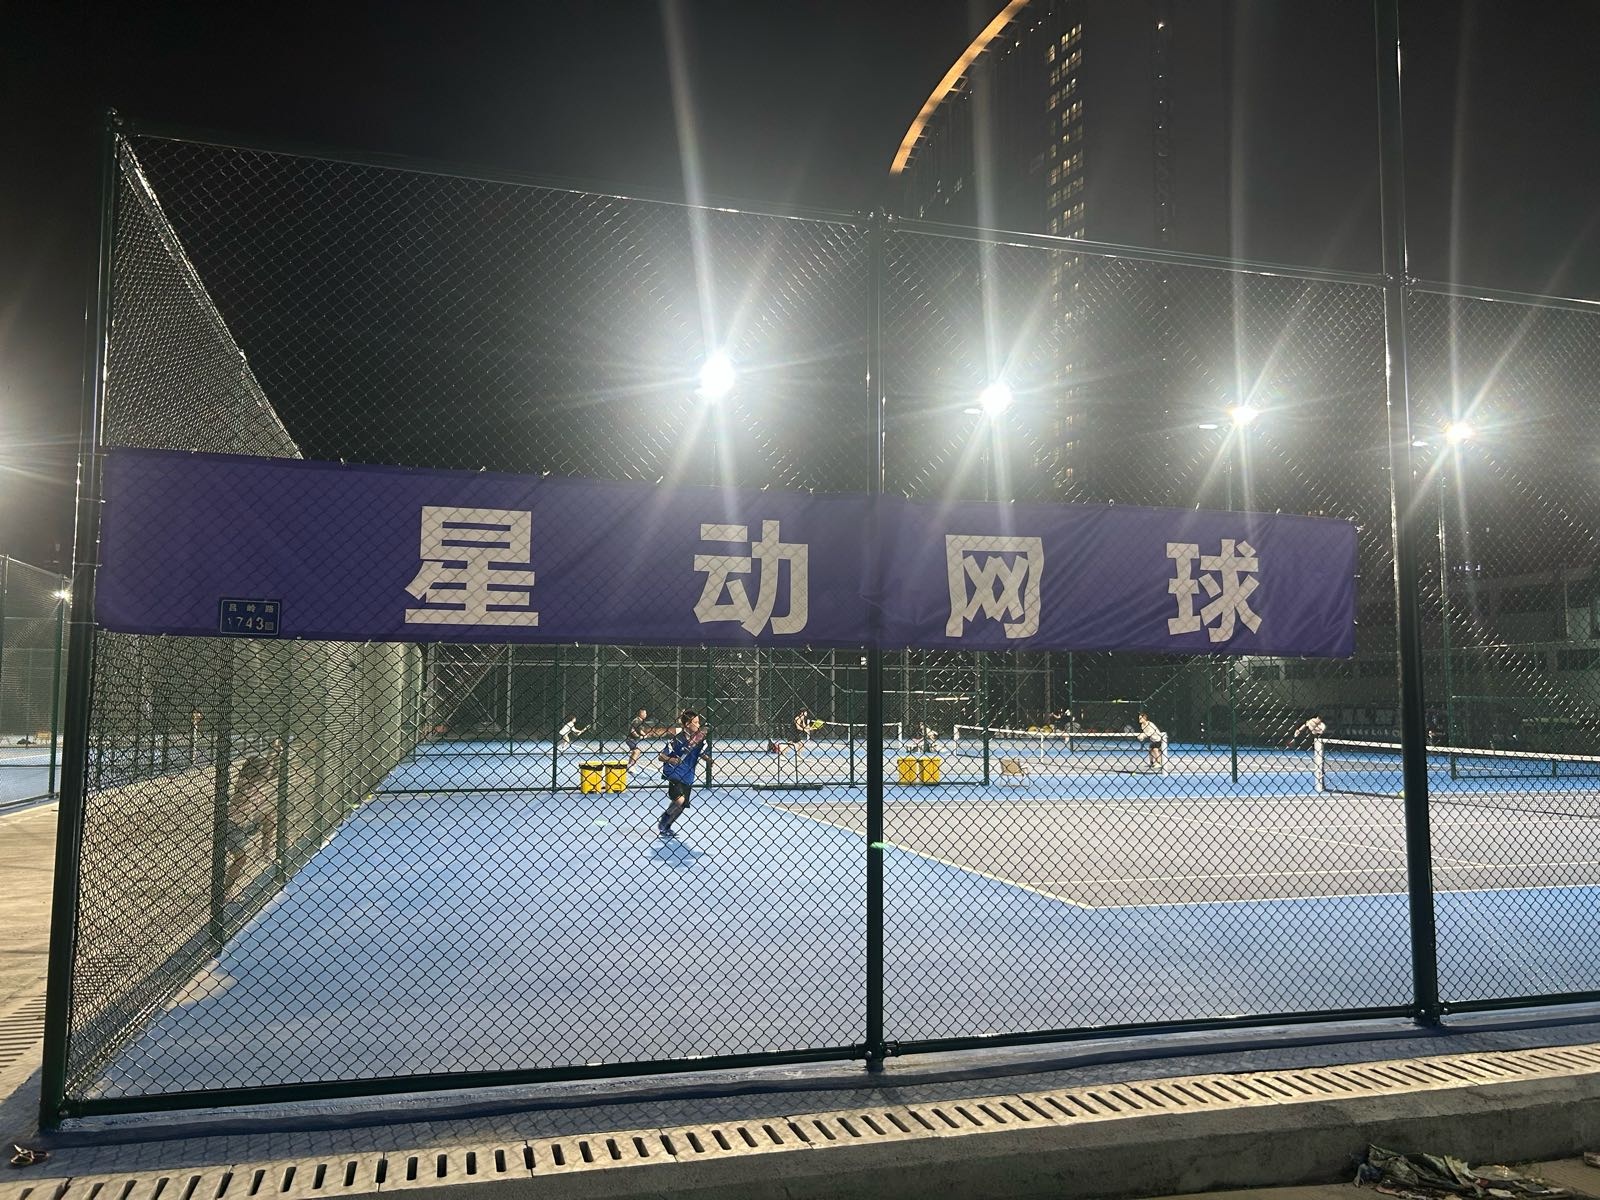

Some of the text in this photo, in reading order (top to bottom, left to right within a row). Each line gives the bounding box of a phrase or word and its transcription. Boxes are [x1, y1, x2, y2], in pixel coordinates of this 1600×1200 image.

[405, 506, 1263, 643] 星动网球
[227, 616, 264, 630] 1743
